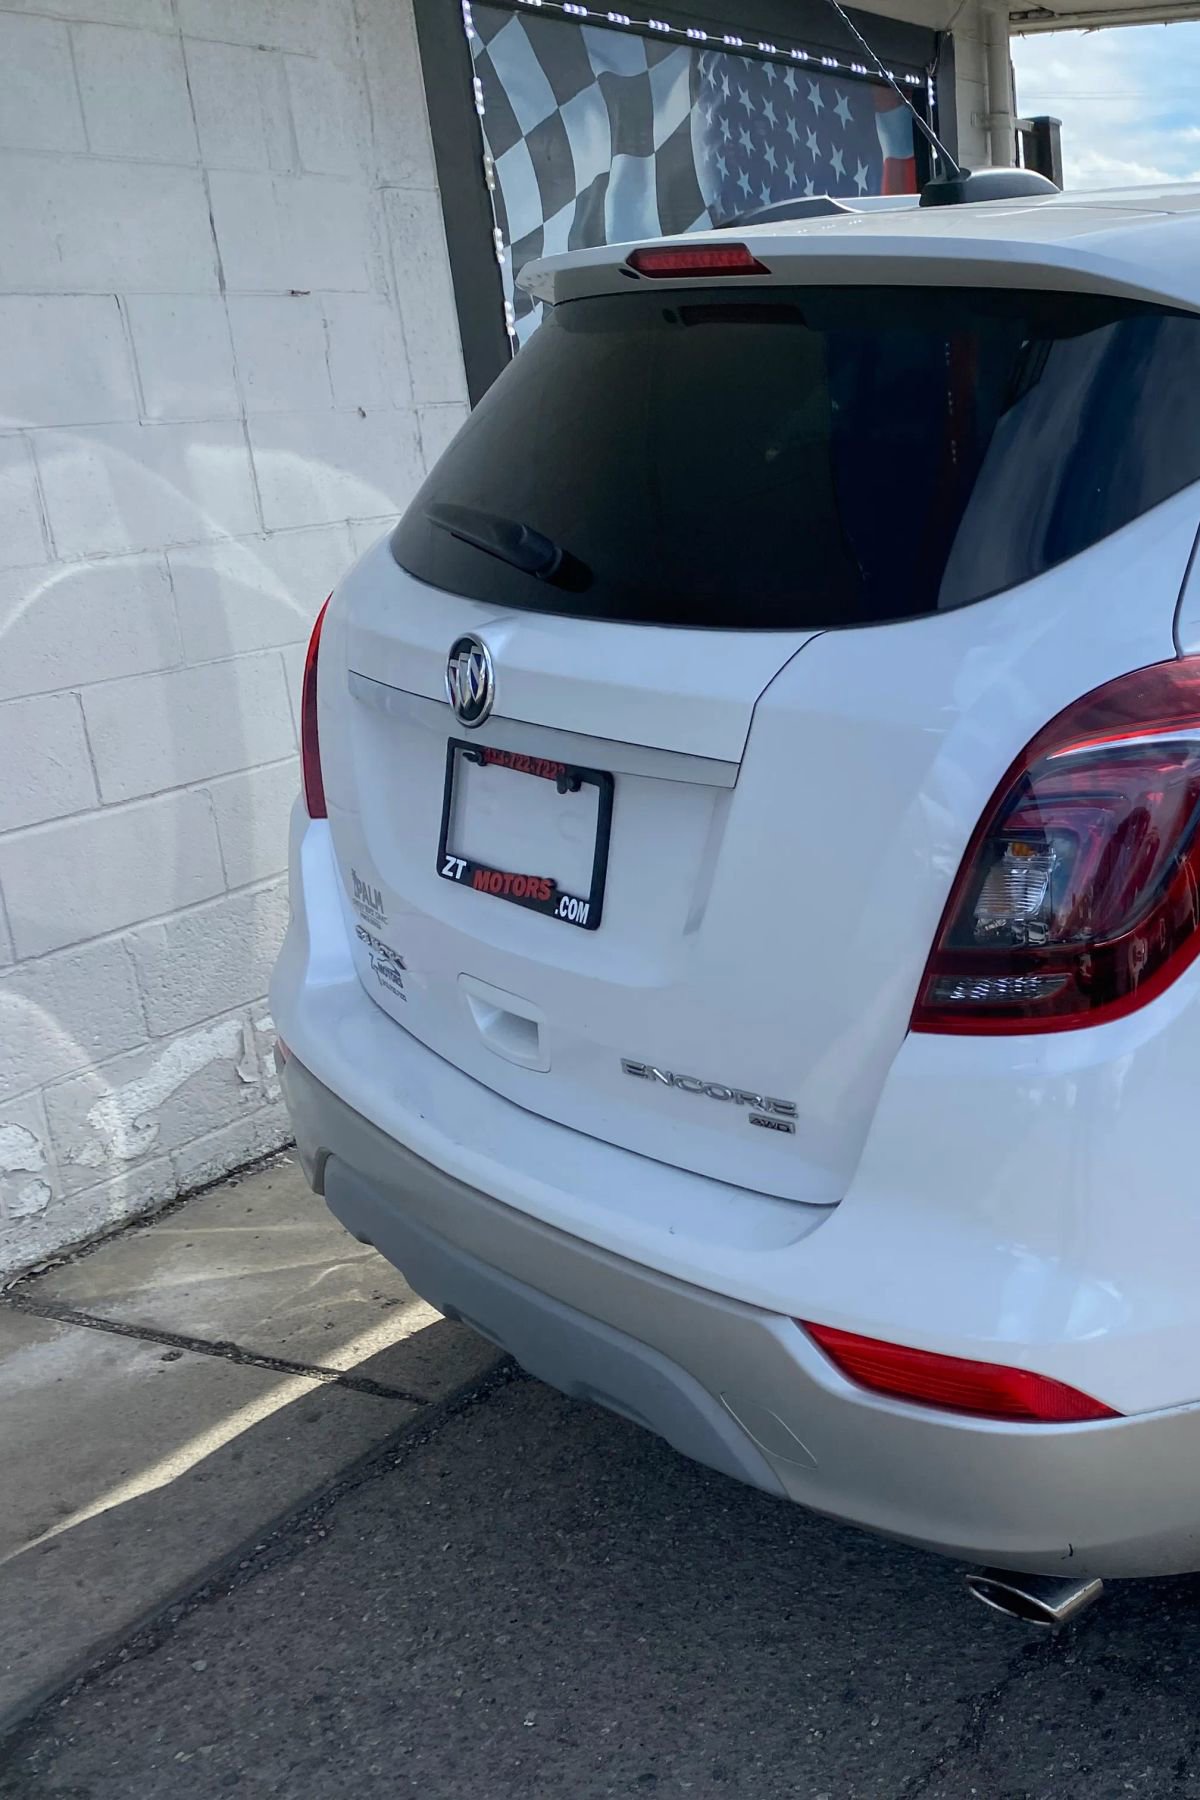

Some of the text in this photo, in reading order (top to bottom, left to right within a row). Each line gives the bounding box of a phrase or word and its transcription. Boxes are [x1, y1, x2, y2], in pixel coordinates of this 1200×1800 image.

[442, 855, 590, 925] ZT MOTORS .COM
[620, 1057, 798, 1118] ENCORE
[750, 1115, 792, 1133] AWD
